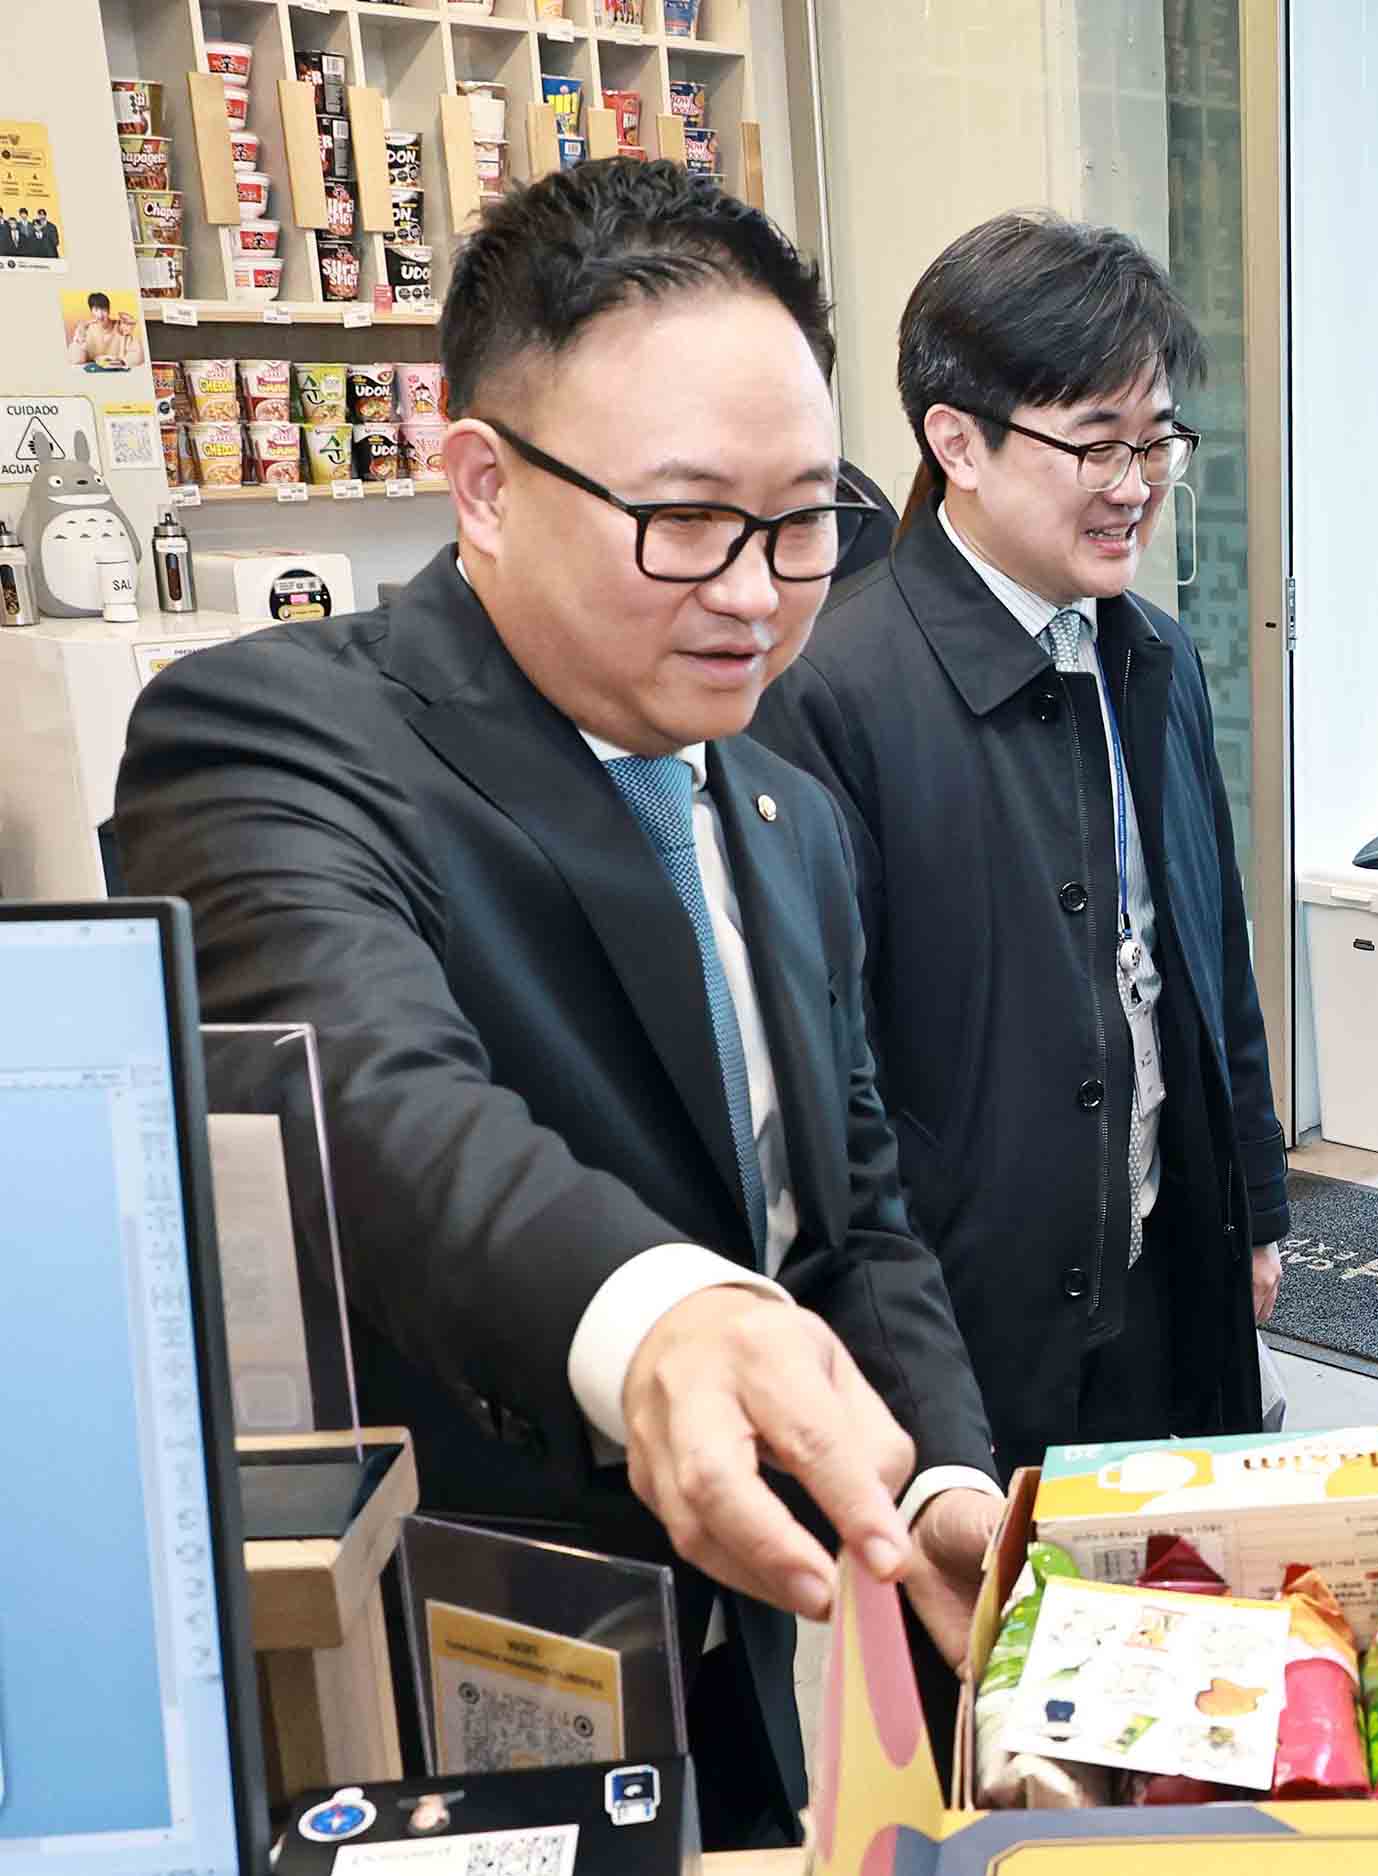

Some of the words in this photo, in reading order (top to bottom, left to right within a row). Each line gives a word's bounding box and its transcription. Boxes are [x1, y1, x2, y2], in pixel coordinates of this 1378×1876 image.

[386, 148, 417, 164] DON
[400, 264, 432, 281] UDO
[6, 404, 59, 416] CUIDADO
[371, 445, 398, 456] UDO
[1, 464, 33, 475] AGUA
[112, 578, 133, 592] SAL
